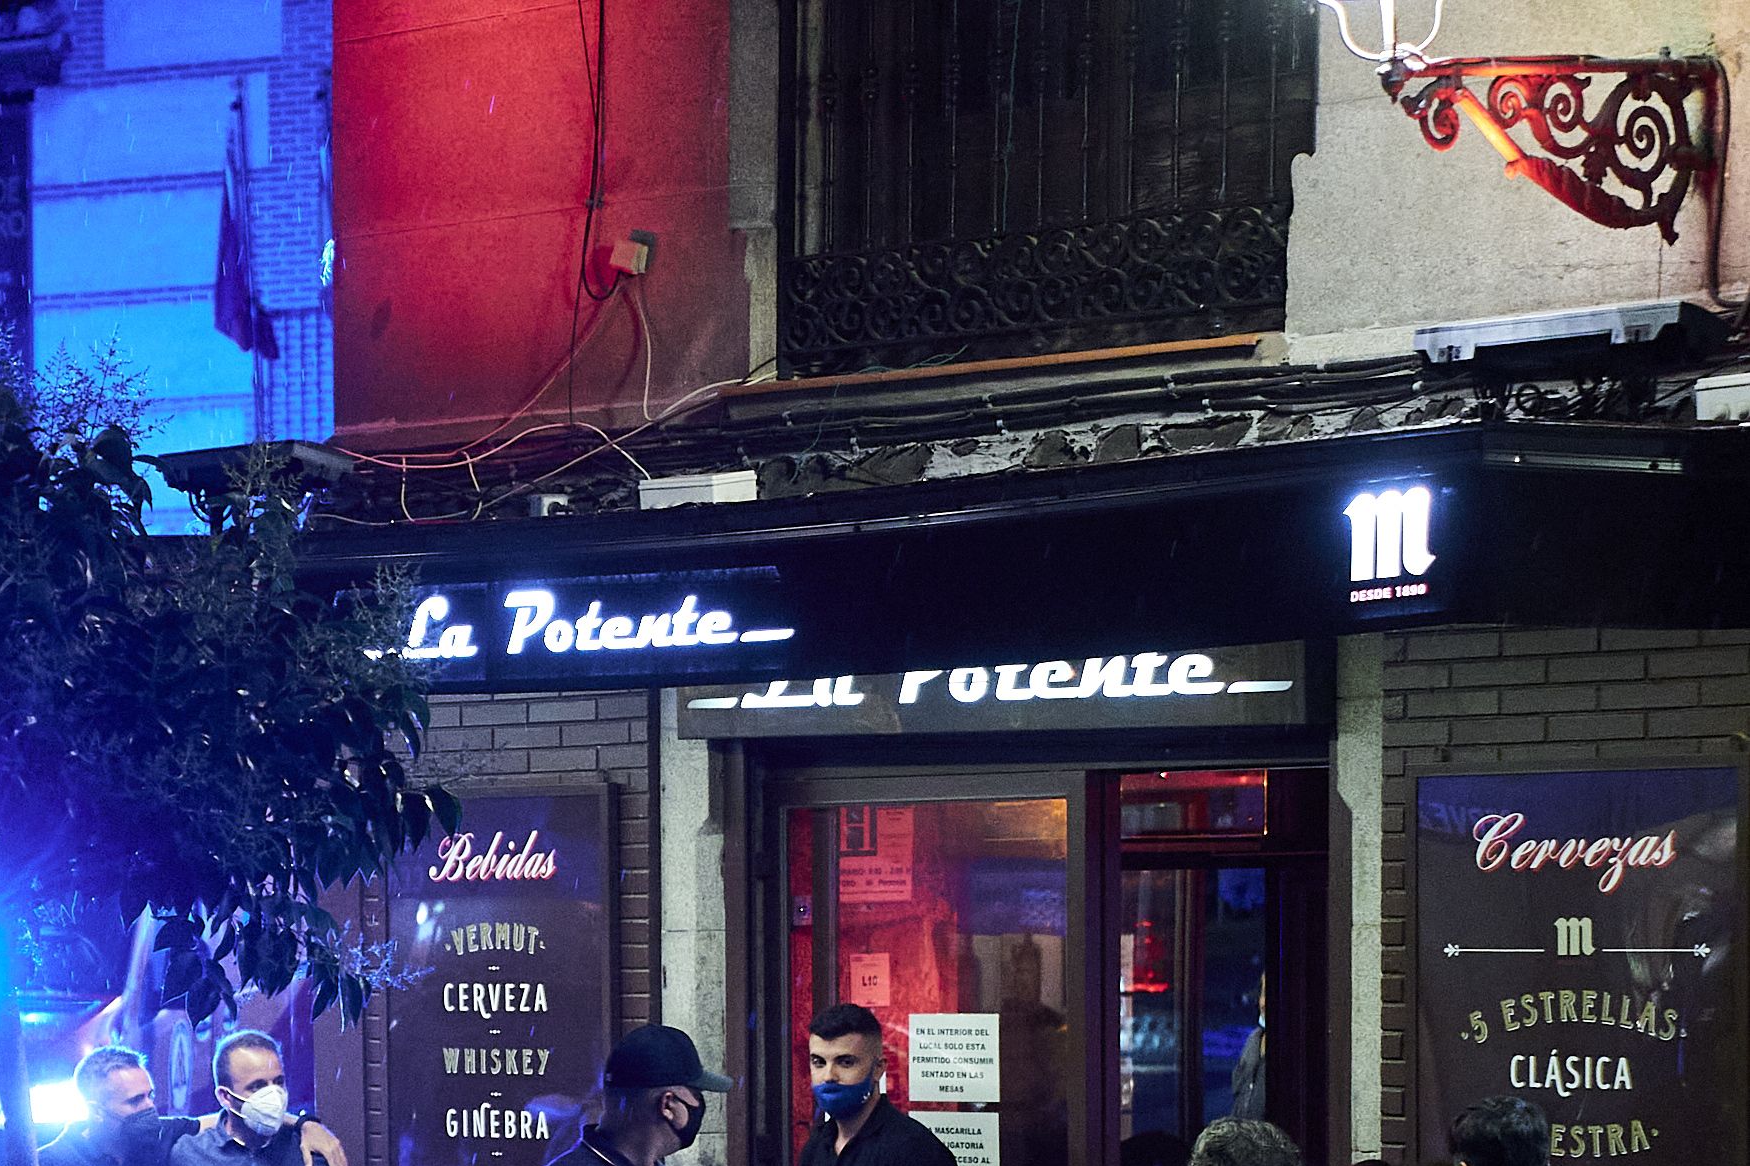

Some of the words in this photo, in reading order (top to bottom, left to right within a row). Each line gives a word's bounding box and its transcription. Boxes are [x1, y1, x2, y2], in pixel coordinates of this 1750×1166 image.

[1350, 586, 1392, 603] DESDE
[1395, 583, 1428, 599] 1890
[405, 595, 478, 659] La
[504, 590, 739, 655] Potente
[428, 829, 558, 882] Bebidas
[1472, 812, 1677, 895] Cervezas
[443, 983, 548, 1019] CERVEZA
[1501, 989, 1678, 1041] ESTRELLAS
[916, 1028, 925, 1036] EN
[927, 1028, 936, 1036] EL
[937, 1028, 973, 1036] INTERIOR
[974, 1028, 990, 1037] DEL
[965, 1043, 986, 1051] ESTA
[443, 1048, 550, 1076] WHISKEY
[912, 1056, 950, 1064] PERMITIDO
[952, 1057, 994, 1065] CONSUMIR
[921, 1071, 955, 1079] SENTADO
[956, 1071, 967, 1079] EN
[969, 1071, 984, 1079] LAS
[1510, 1049, 1634, 1097] CLÁSICA
[939, 1085, 964, 1093] MESAS
[446, 1102, 550, 1140] GINEBRA
[934, 1127, 982, 1135] MASCARILLA
[944, 1141, 984, 1150] IGATORIA
[1551, 1119, 1651, 1158] ESTRA
[954, 1156, 979, 1164] CESO
[981, 1156, 991, 1164] AL
